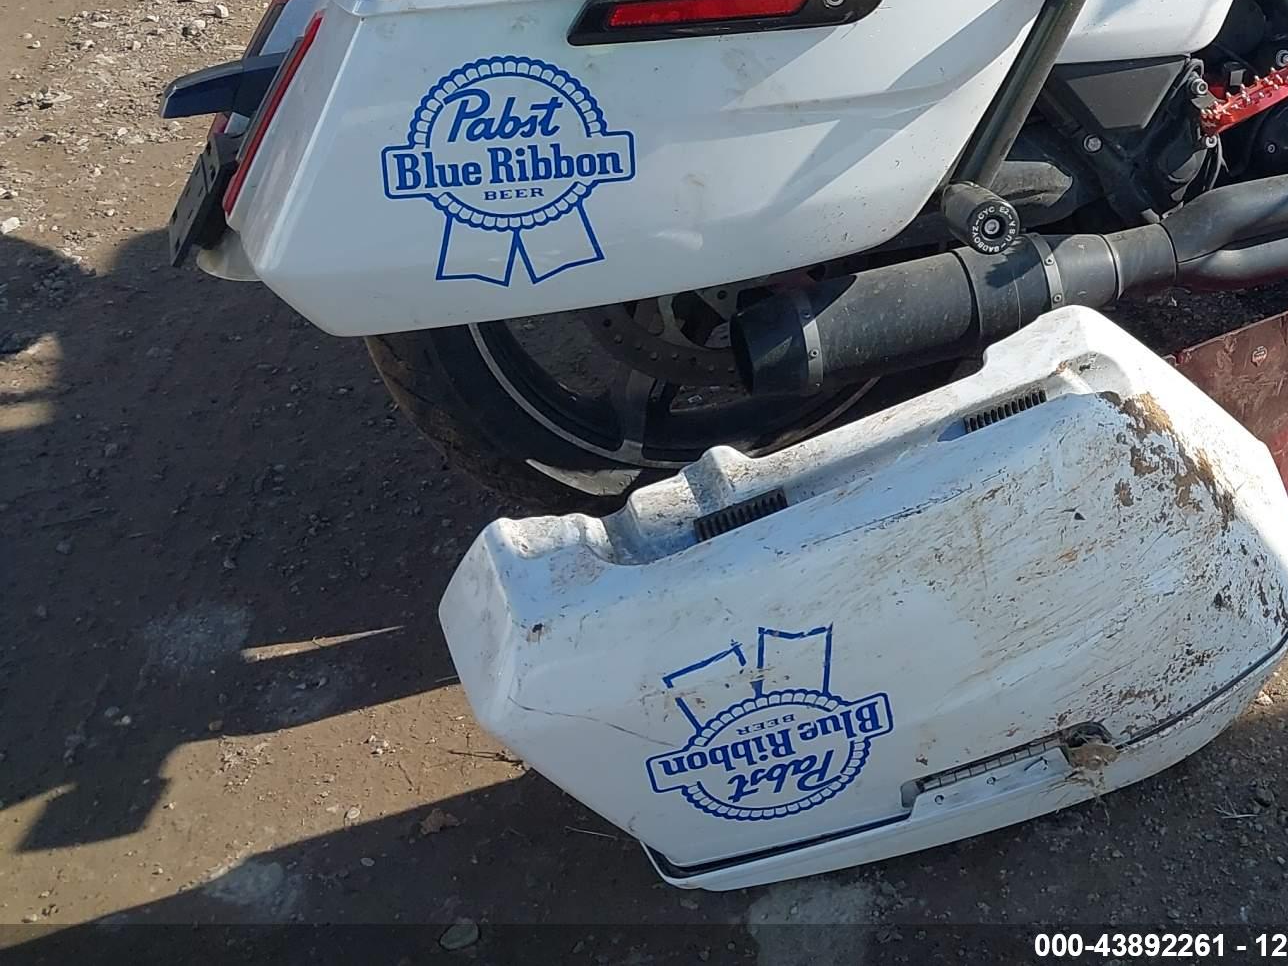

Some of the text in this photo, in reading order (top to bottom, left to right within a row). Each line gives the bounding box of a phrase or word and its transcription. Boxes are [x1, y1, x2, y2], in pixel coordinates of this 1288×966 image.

[443, 88, 563, 143] Pabst
[393, 143, 624, 191] Blue Ribbon
[484, 188, 545, 201] BEER
[658, 701, 883, 776] Blue Ribbon
[736, 714, 796, 735] BEER
[727, 749, 842, 803] Pabst
